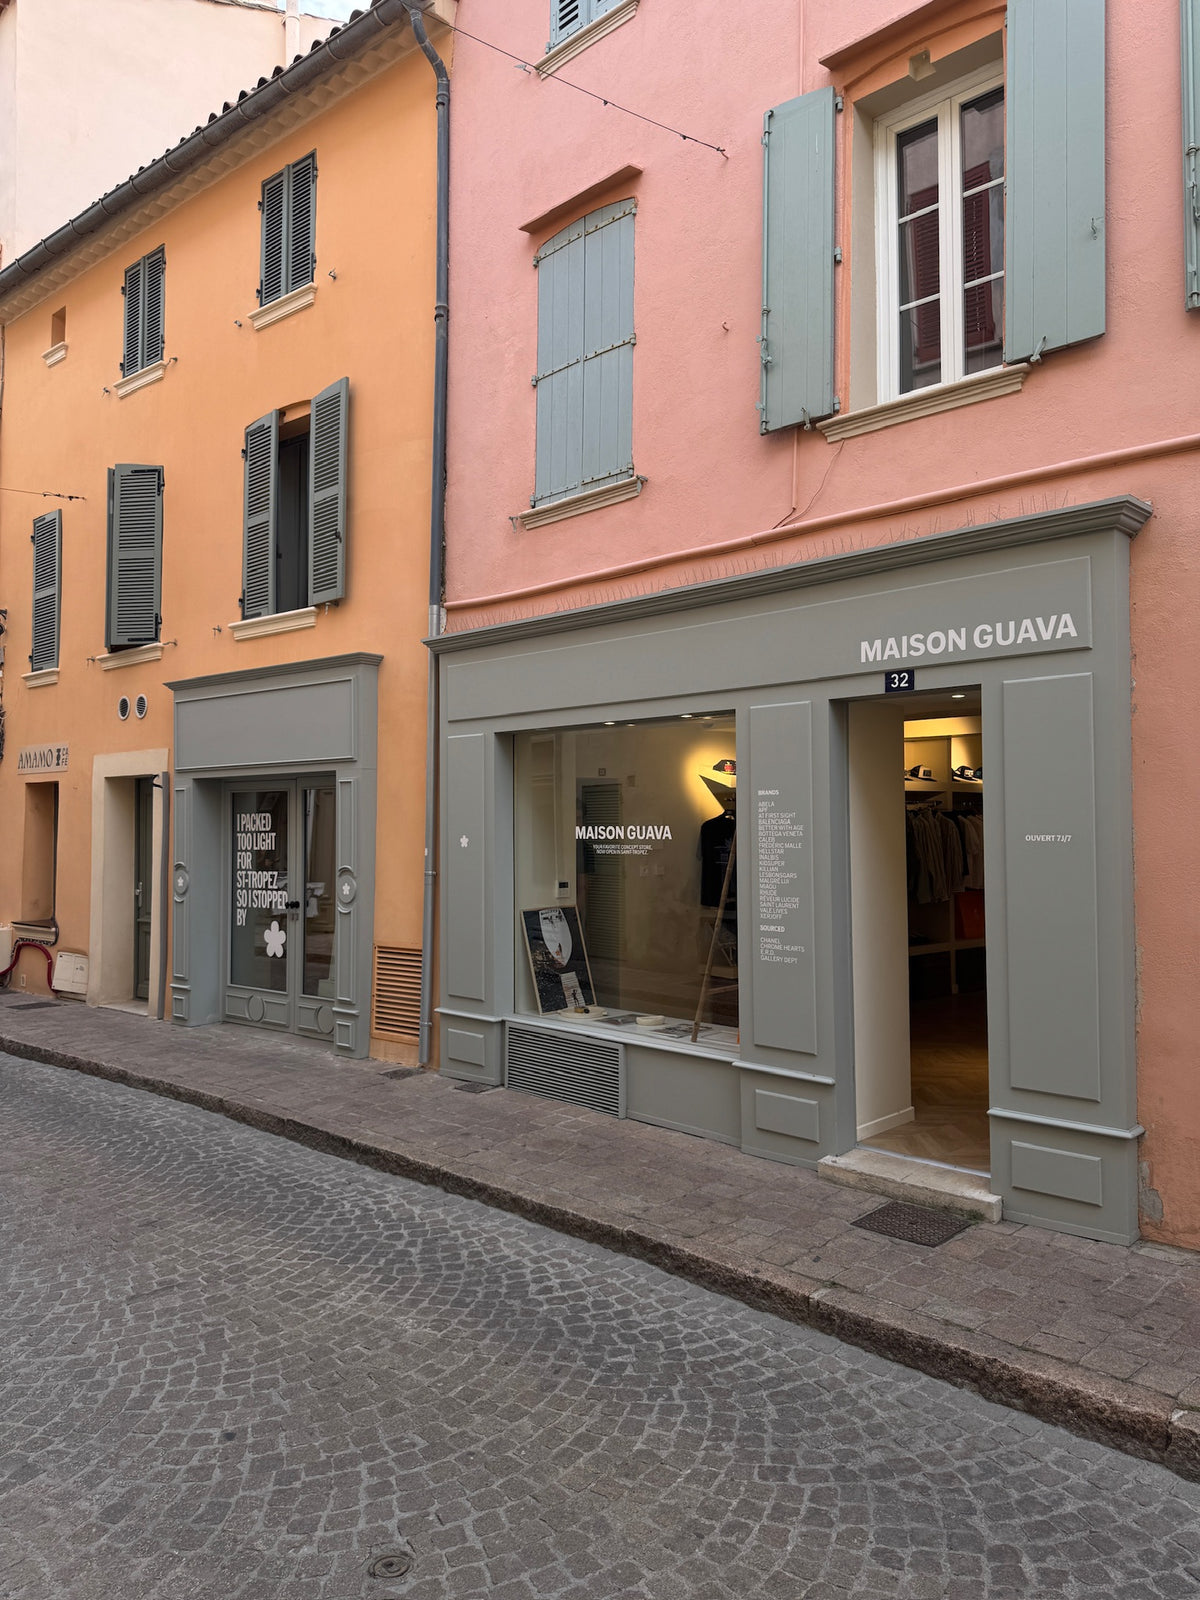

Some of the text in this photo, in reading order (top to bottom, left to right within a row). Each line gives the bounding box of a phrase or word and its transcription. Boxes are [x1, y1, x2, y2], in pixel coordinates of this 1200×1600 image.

[860, 613, 1078, 663] MAISON GUAVA
[890, 672, 909, 688] 32
[17, 748, 54, 770] AMAMO
[236, 813, 272, 832] I PACKED
[236, 832, 277, 851] TOO LIGHT
[575, 825, 673, 840] MAISON GUAVA
[1025, 834, 1056, 842] OUVERT
[236, 851, 253, 870] FOR
[236, 870, 279, 889] ST-TROPEZ
[236, 889, 247, 908] SO
[252, 889, 288, 910] STOPPED
[236, 908, 247, 926] BY
[759, 924, 785, 933] SOURCED
[783, 944, 805, 953] HEARTS
